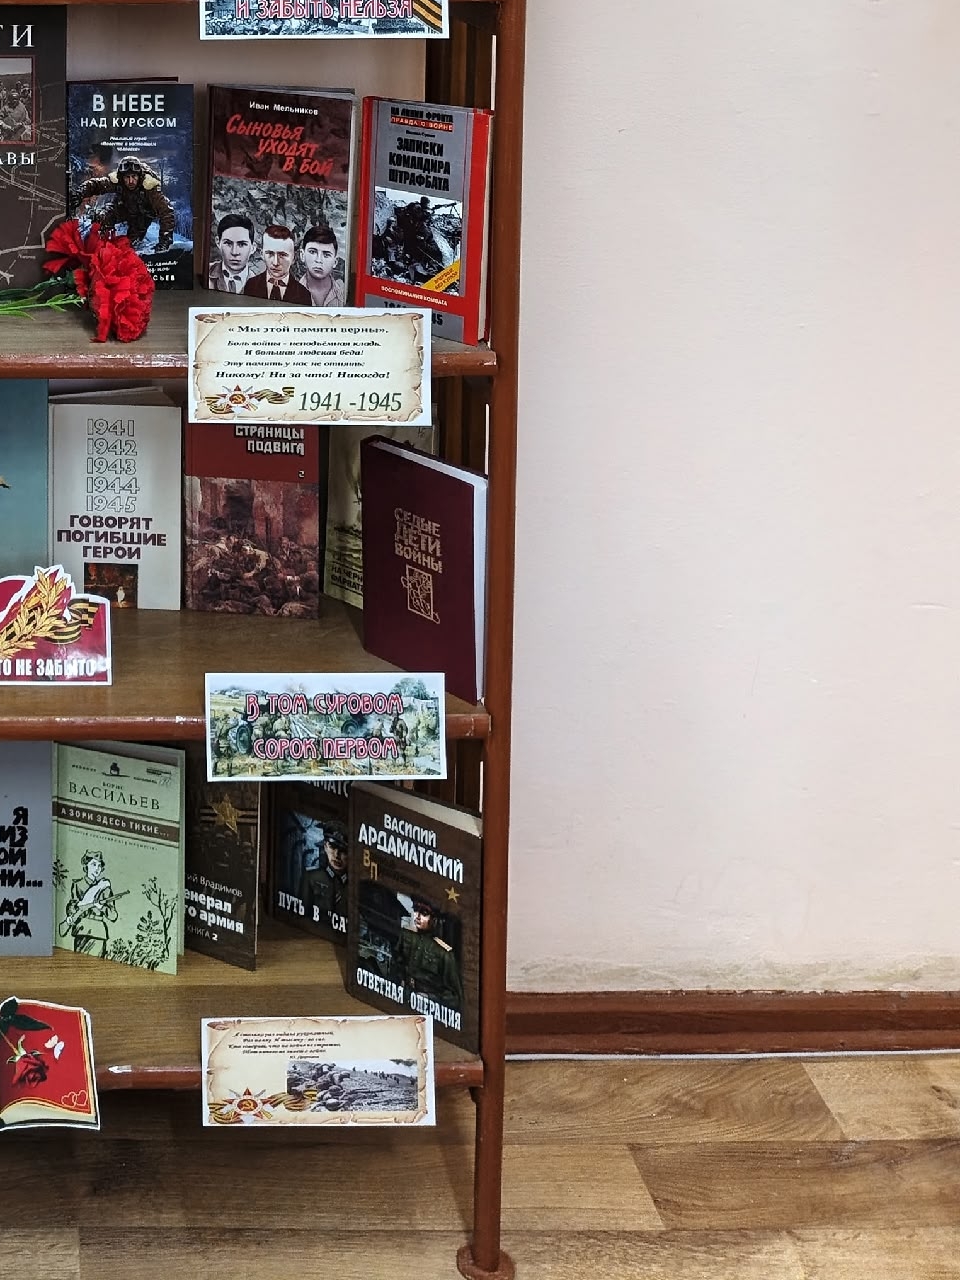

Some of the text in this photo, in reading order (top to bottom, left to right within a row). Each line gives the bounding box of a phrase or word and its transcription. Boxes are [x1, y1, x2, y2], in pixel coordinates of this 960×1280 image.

[236, 0, 249, 19] И
[93, 94, 164, 111] В НЕБЕ
[81, 118, 176, 128] НАД КУРСКОМ
[397, 137, 444, 157] ЗАПИСКИ
[389, 152, 451, 175] КОМАНДИРА
[215, 371, 265, 379] Никому!
[337, 371, 390, 379] Никогда!
[86, 419, 135, 436] 1941
[86, 438, 138, 456] 1942
[248, 441, 305, 455] ПОДВИГА
[86, 458, 137, 475] 1943
[86, 477, 140, 494] 1944
[86, 496, 137, 513] 1945
[70, 515, 153, 531] ГОВОРЯТ
[57, 530, 167, 546] ПОГИБШИЕ
[82, 545, 141, 559] ГЕРОИ
[253, 737, 398, 759] СОРОК ПЕРВОМ
[69, 782, 160, 810] ВАСИЛЬЕВ
[12, 806, 29, 825] Я
[0, 824, 28, 847] ИЗ
[384, 813, 436, 848] ВАСИЛИЙ
[358, 823, 463, 884] АРДАМАТСКИЙ
[278, 890, 319, 922] ПУТЬ В
[200, 912, 244, 934] армия
[357, 967, 461, 1031] ОТВЕТНАЯ ОПЕРАЦИЯ
